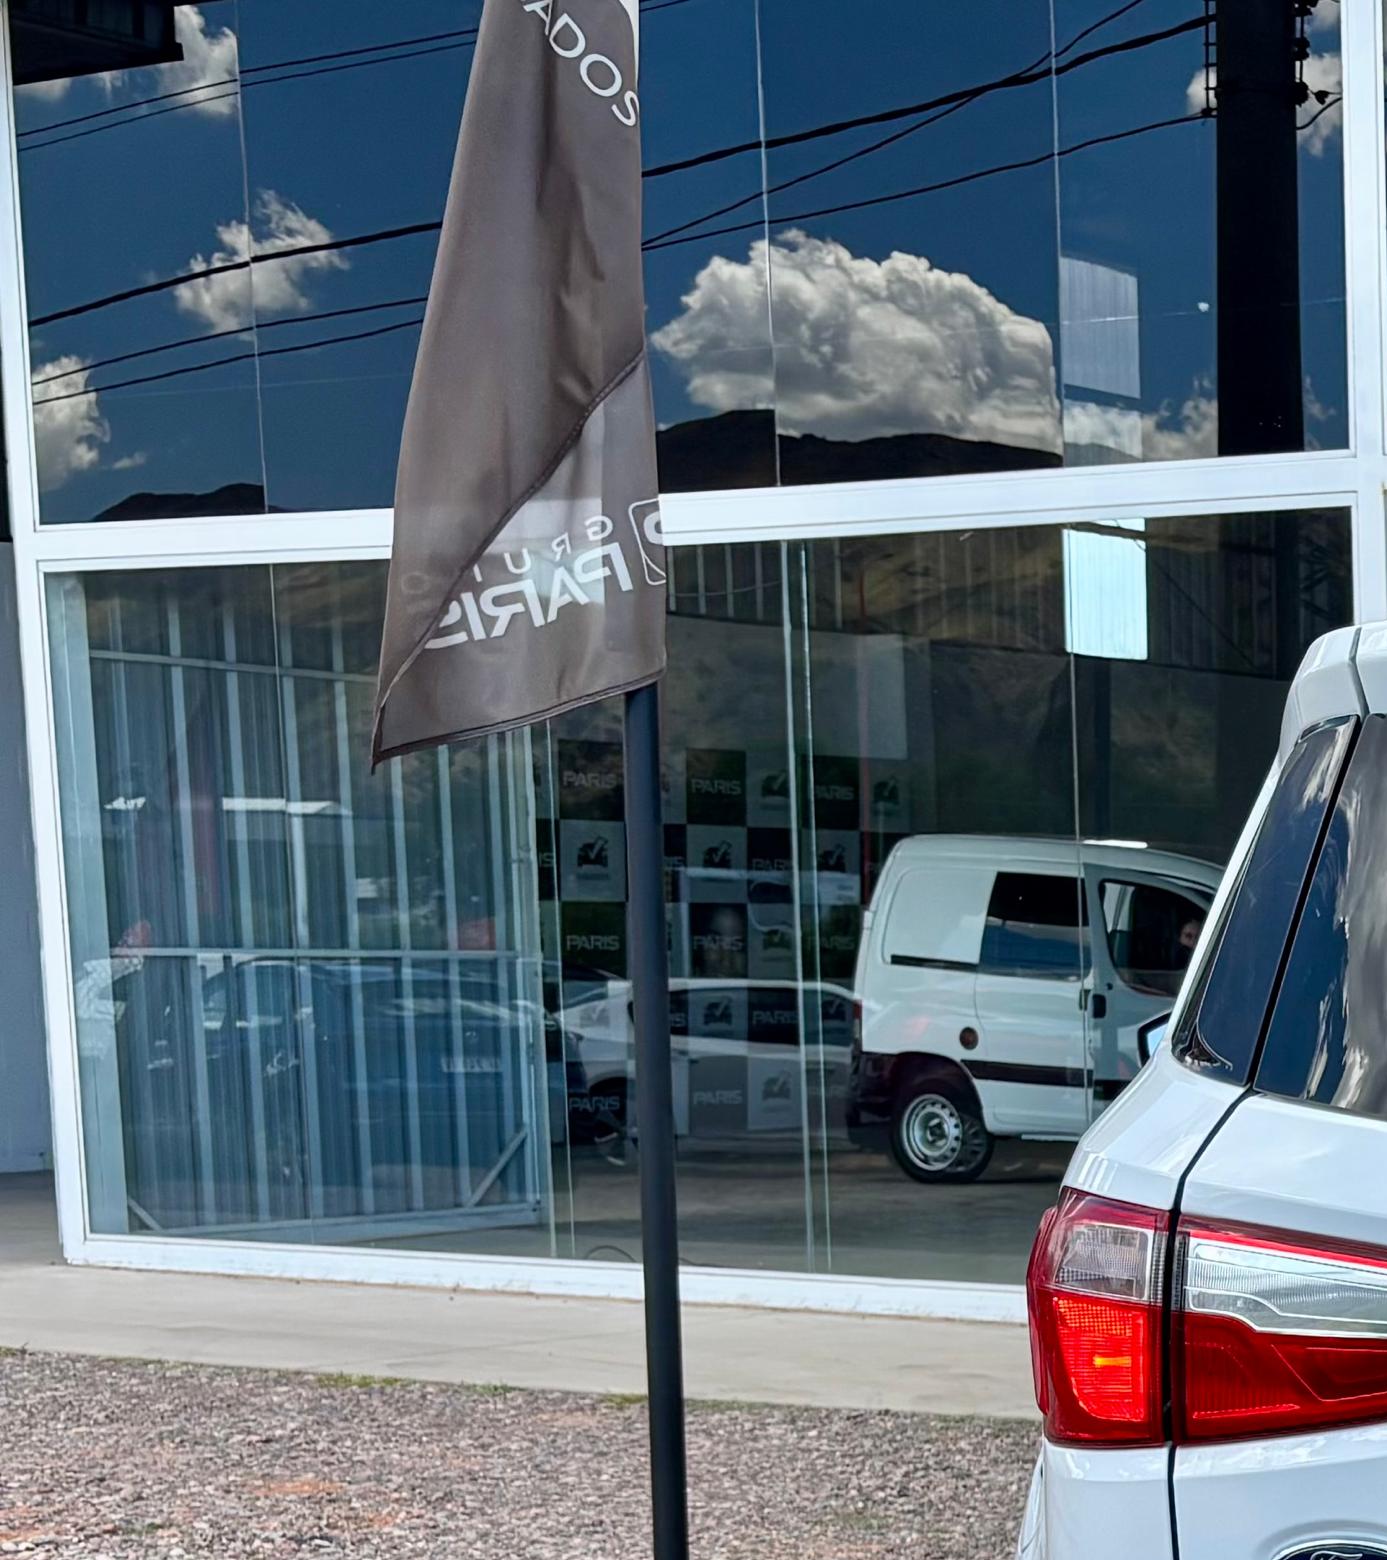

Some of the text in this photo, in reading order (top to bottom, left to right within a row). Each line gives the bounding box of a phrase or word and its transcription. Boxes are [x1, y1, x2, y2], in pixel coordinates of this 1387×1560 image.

[562, 769, 618, 788] PARIS
[691, 778, 742, 796] PARIS
[566, 934, 620, 952] PARIS
[693, 934, 744, 951] PARIS
[569, 1095, 620, 1113] PARIS
[693, 1089, 744, 1105] PARIS
